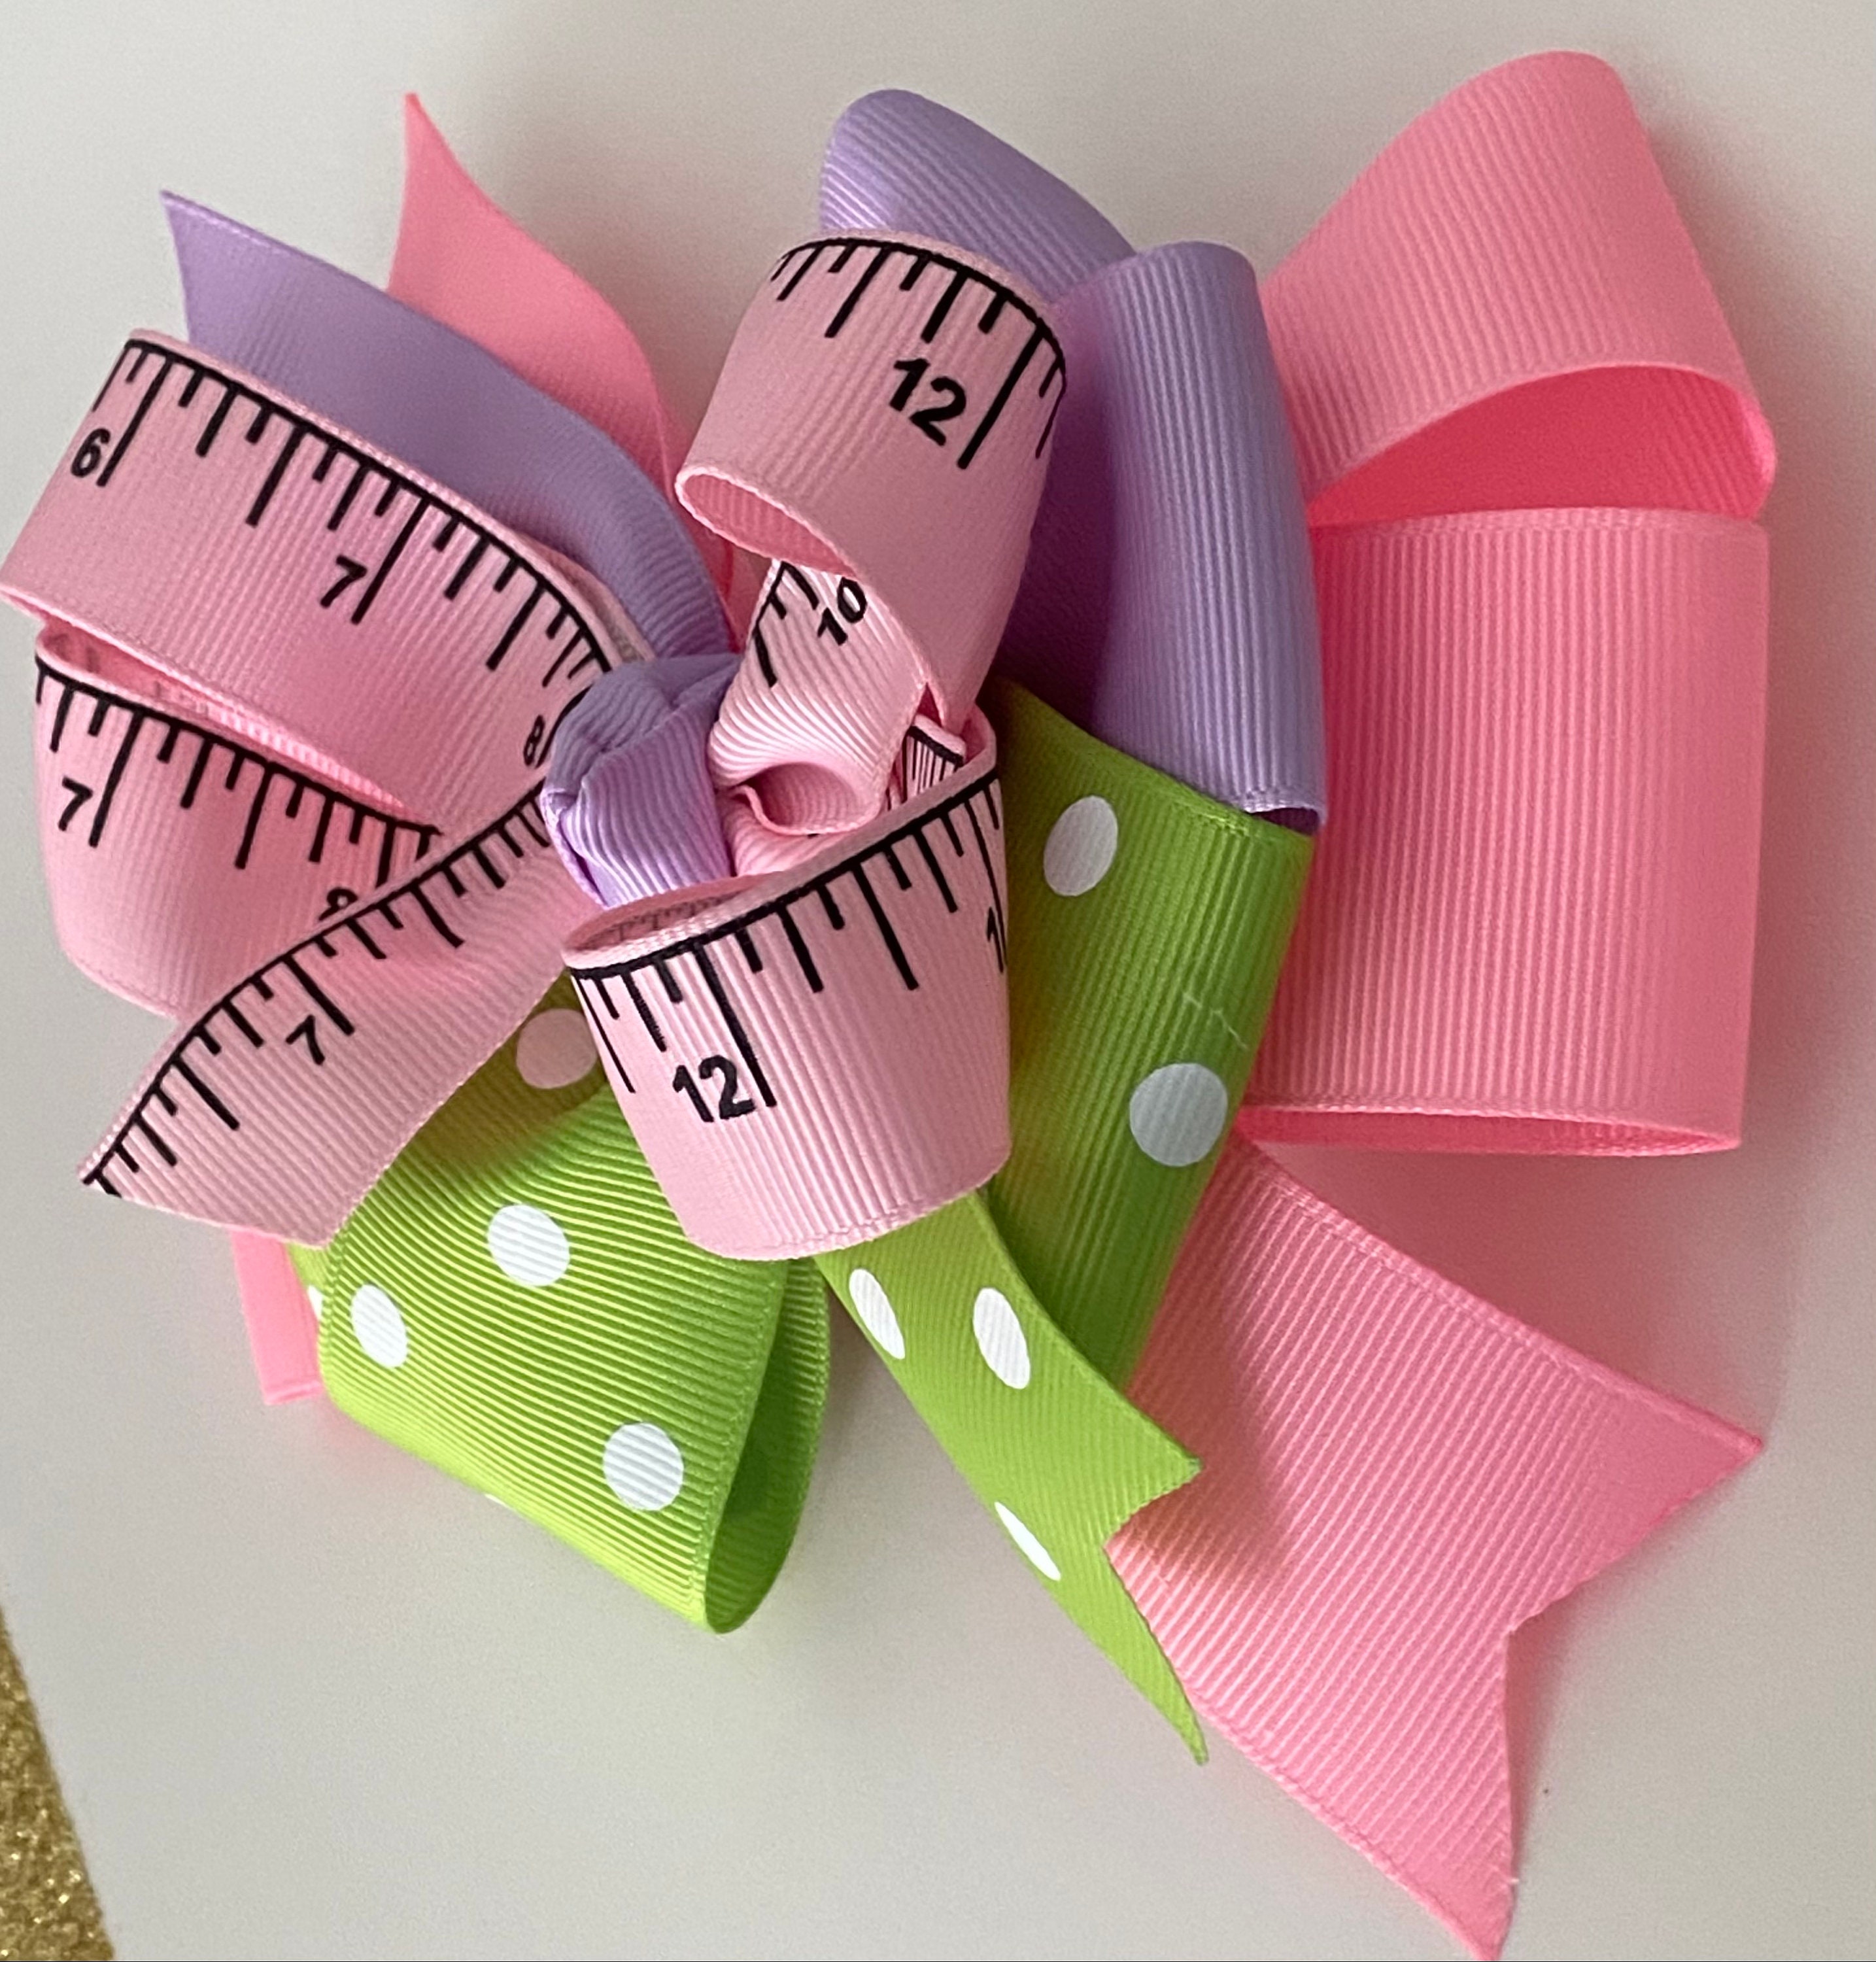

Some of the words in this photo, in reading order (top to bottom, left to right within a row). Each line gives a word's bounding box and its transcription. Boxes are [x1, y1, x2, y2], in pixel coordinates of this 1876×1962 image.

[889, 358, 967, 447] 12
[71, 428, 111, 478] 6
[320, 555, 367, 608] 7
[817, 577, 867, 645] 10
[523, 714, 545, 766] 8
[58, 778, 92, 831] 7
[285, 1014, 325, 1065] 7
[673, 1055, 756, 1123] 12
